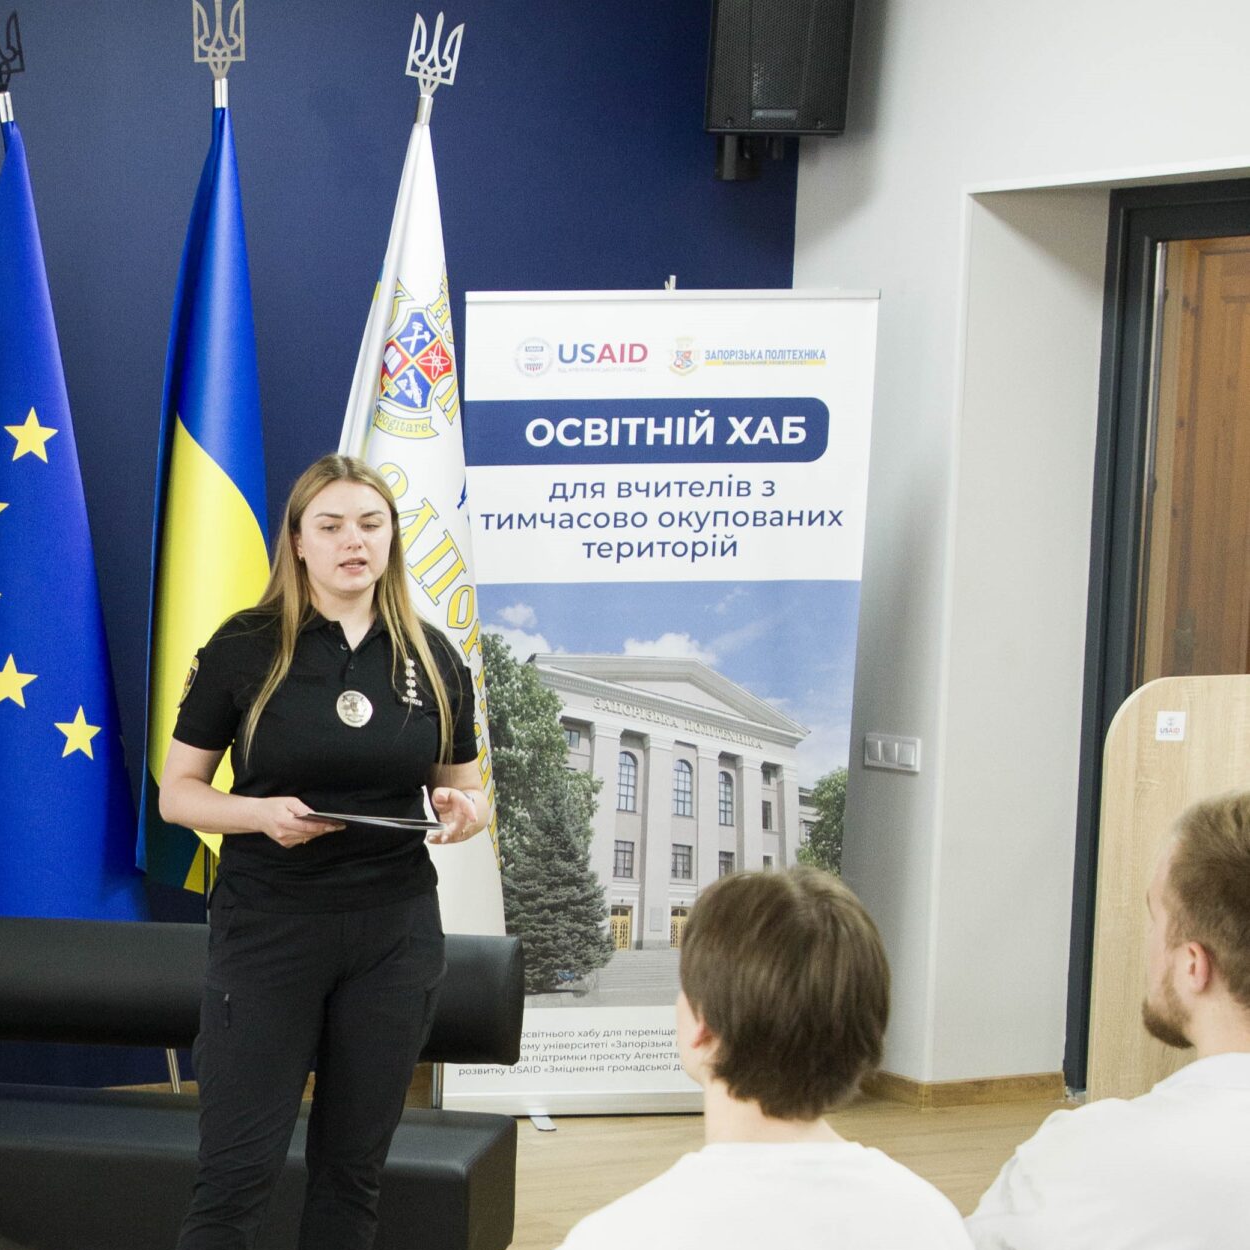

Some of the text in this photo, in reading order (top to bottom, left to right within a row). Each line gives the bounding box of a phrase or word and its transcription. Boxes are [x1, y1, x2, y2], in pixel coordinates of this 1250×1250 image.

[557, 343, 649, 364] USAID
[704, 349, 827, 361] ЗАПОРІЗЬКА ПОЛІТЕХНІКА
[525, 409, 808, 447] ОСВІТНІЙ ХАБ
[548, 474, 776, 503] для вчителів з
[480, 508, 844, 535] тимчасово окупованих
[581, 534, 739, 564] територій
[593, 697, 679, 729] ЗАПОРІЗЬКА
[577, 1028, 600, 1039] хабу
[603, 1029, 622, 1038] для
[624, 1027, 677, 1038] переміще
[543, 1040, 608, 1051] університеті
[532, 1053, 587, 1063] підтримки
[633, 1051, 680, 1060] Агентств
[458, 1067, 506, 1076] розвитку
[509, 1065, 542, 1074] USAID
[607, 1063, 671, 1073] громадської
